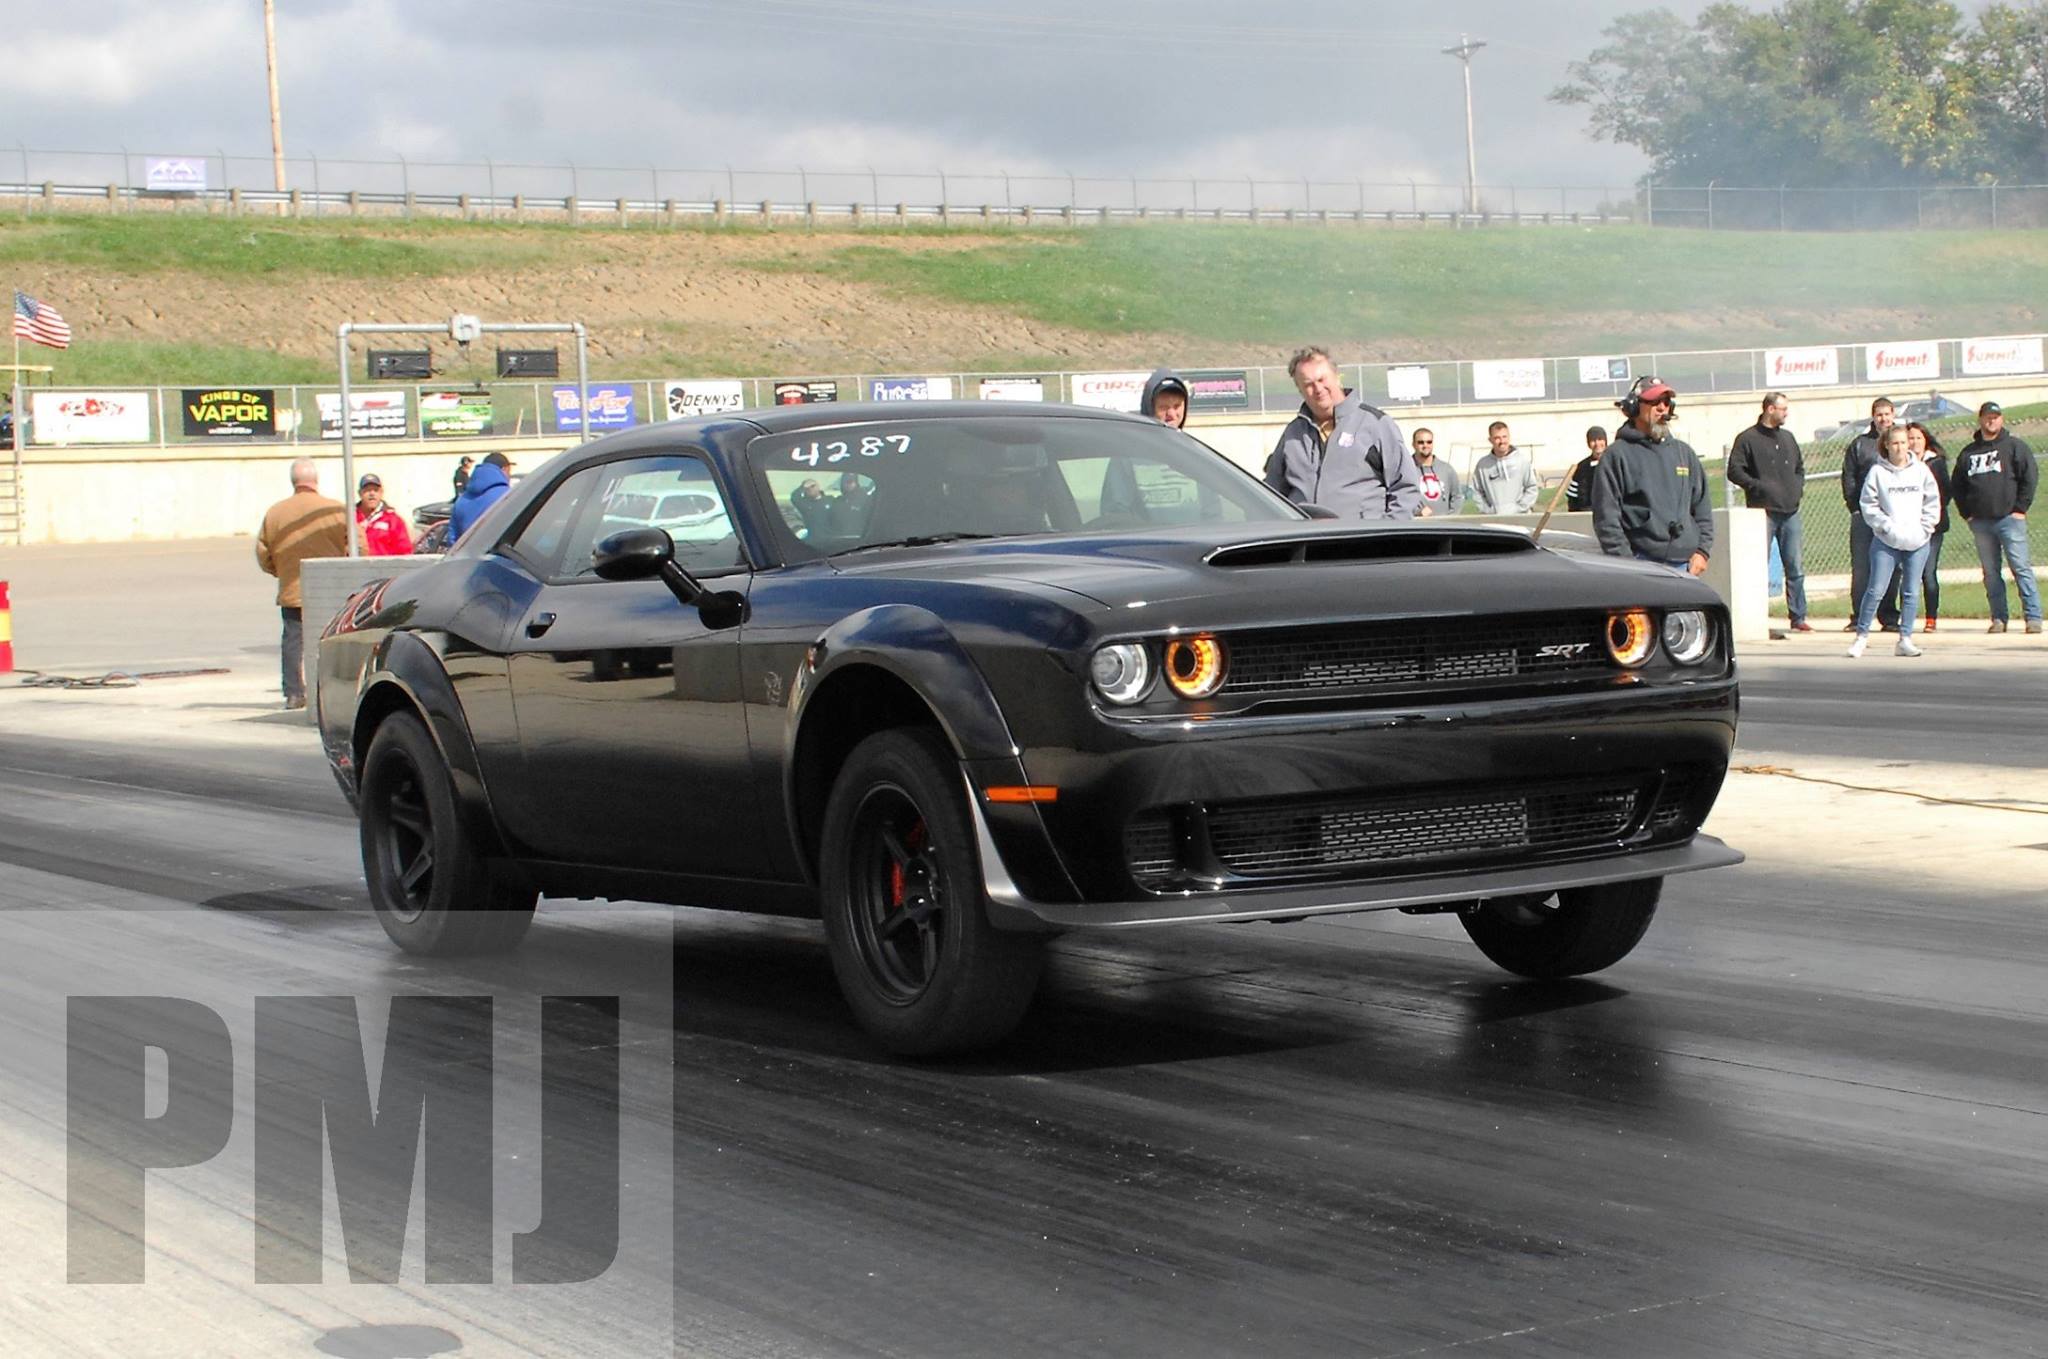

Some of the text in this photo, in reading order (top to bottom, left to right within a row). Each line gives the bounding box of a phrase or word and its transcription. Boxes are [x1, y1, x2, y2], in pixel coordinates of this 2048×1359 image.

[200, 391, 261, 404] KINGS OF
[189, 404, 269, 422] VAPOR
[792, 435, 911, 467] 4287
[1536, 643, 1590, 659] SRT
